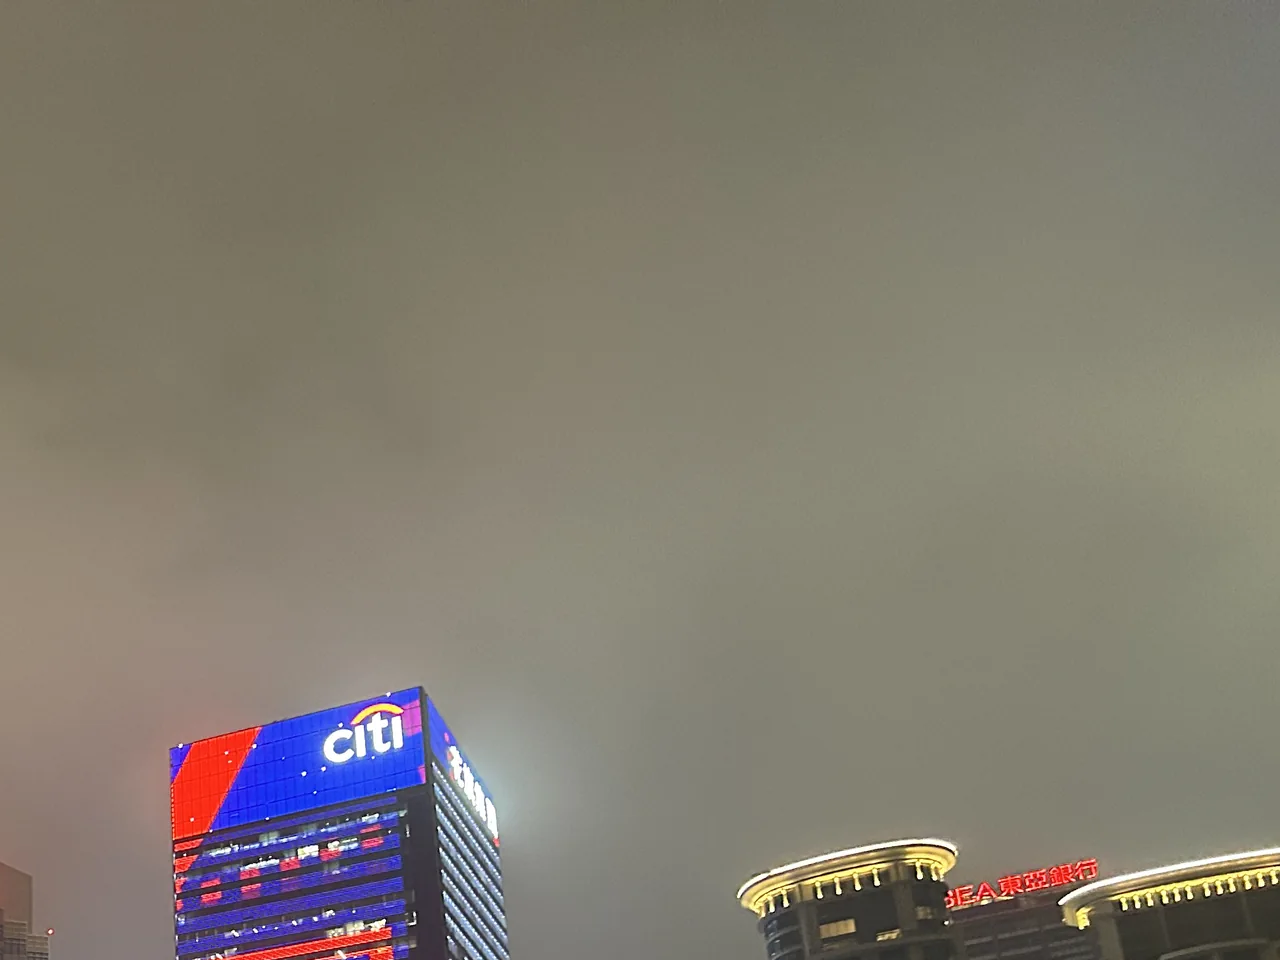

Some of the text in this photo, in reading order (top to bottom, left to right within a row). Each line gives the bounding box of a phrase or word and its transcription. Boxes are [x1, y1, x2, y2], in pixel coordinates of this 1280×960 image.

[322, 711, 405, 763] citi
[997, 858, 1098, 898] 東亞銀行
